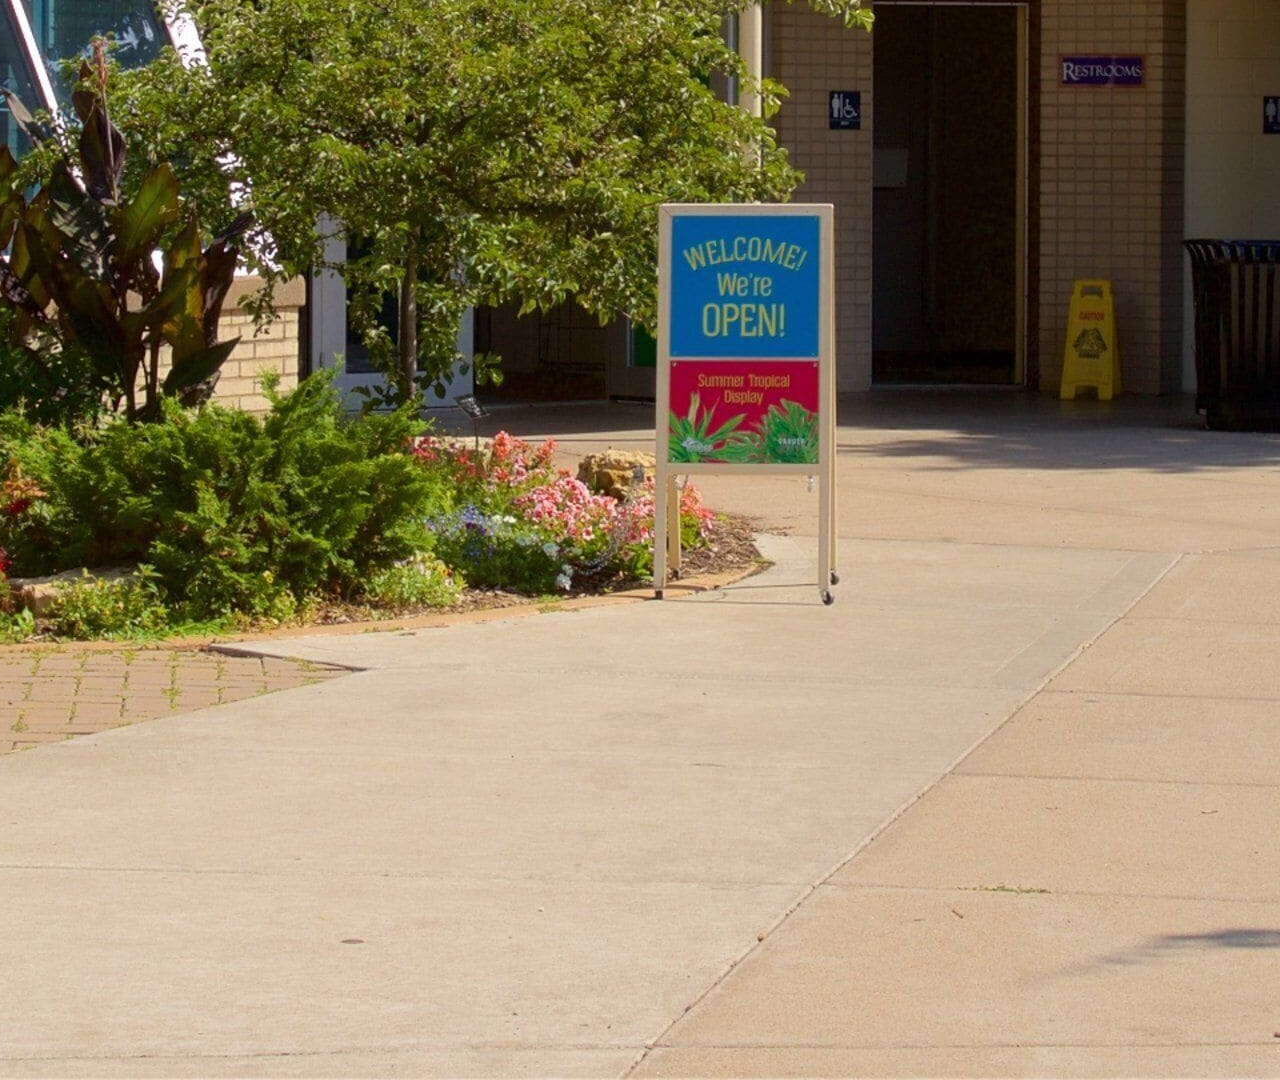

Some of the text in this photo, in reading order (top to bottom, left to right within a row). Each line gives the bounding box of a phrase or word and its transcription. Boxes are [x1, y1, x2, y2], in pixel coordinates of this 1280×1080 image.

[683, 236, 808, 271] WELCOME!
[717, 272, 773, 297] We're
[702, 303, 786, 338] OPEN!
[697, 373, 790, 388] Summer Tropical
[723, 389, 764, 406] Display
